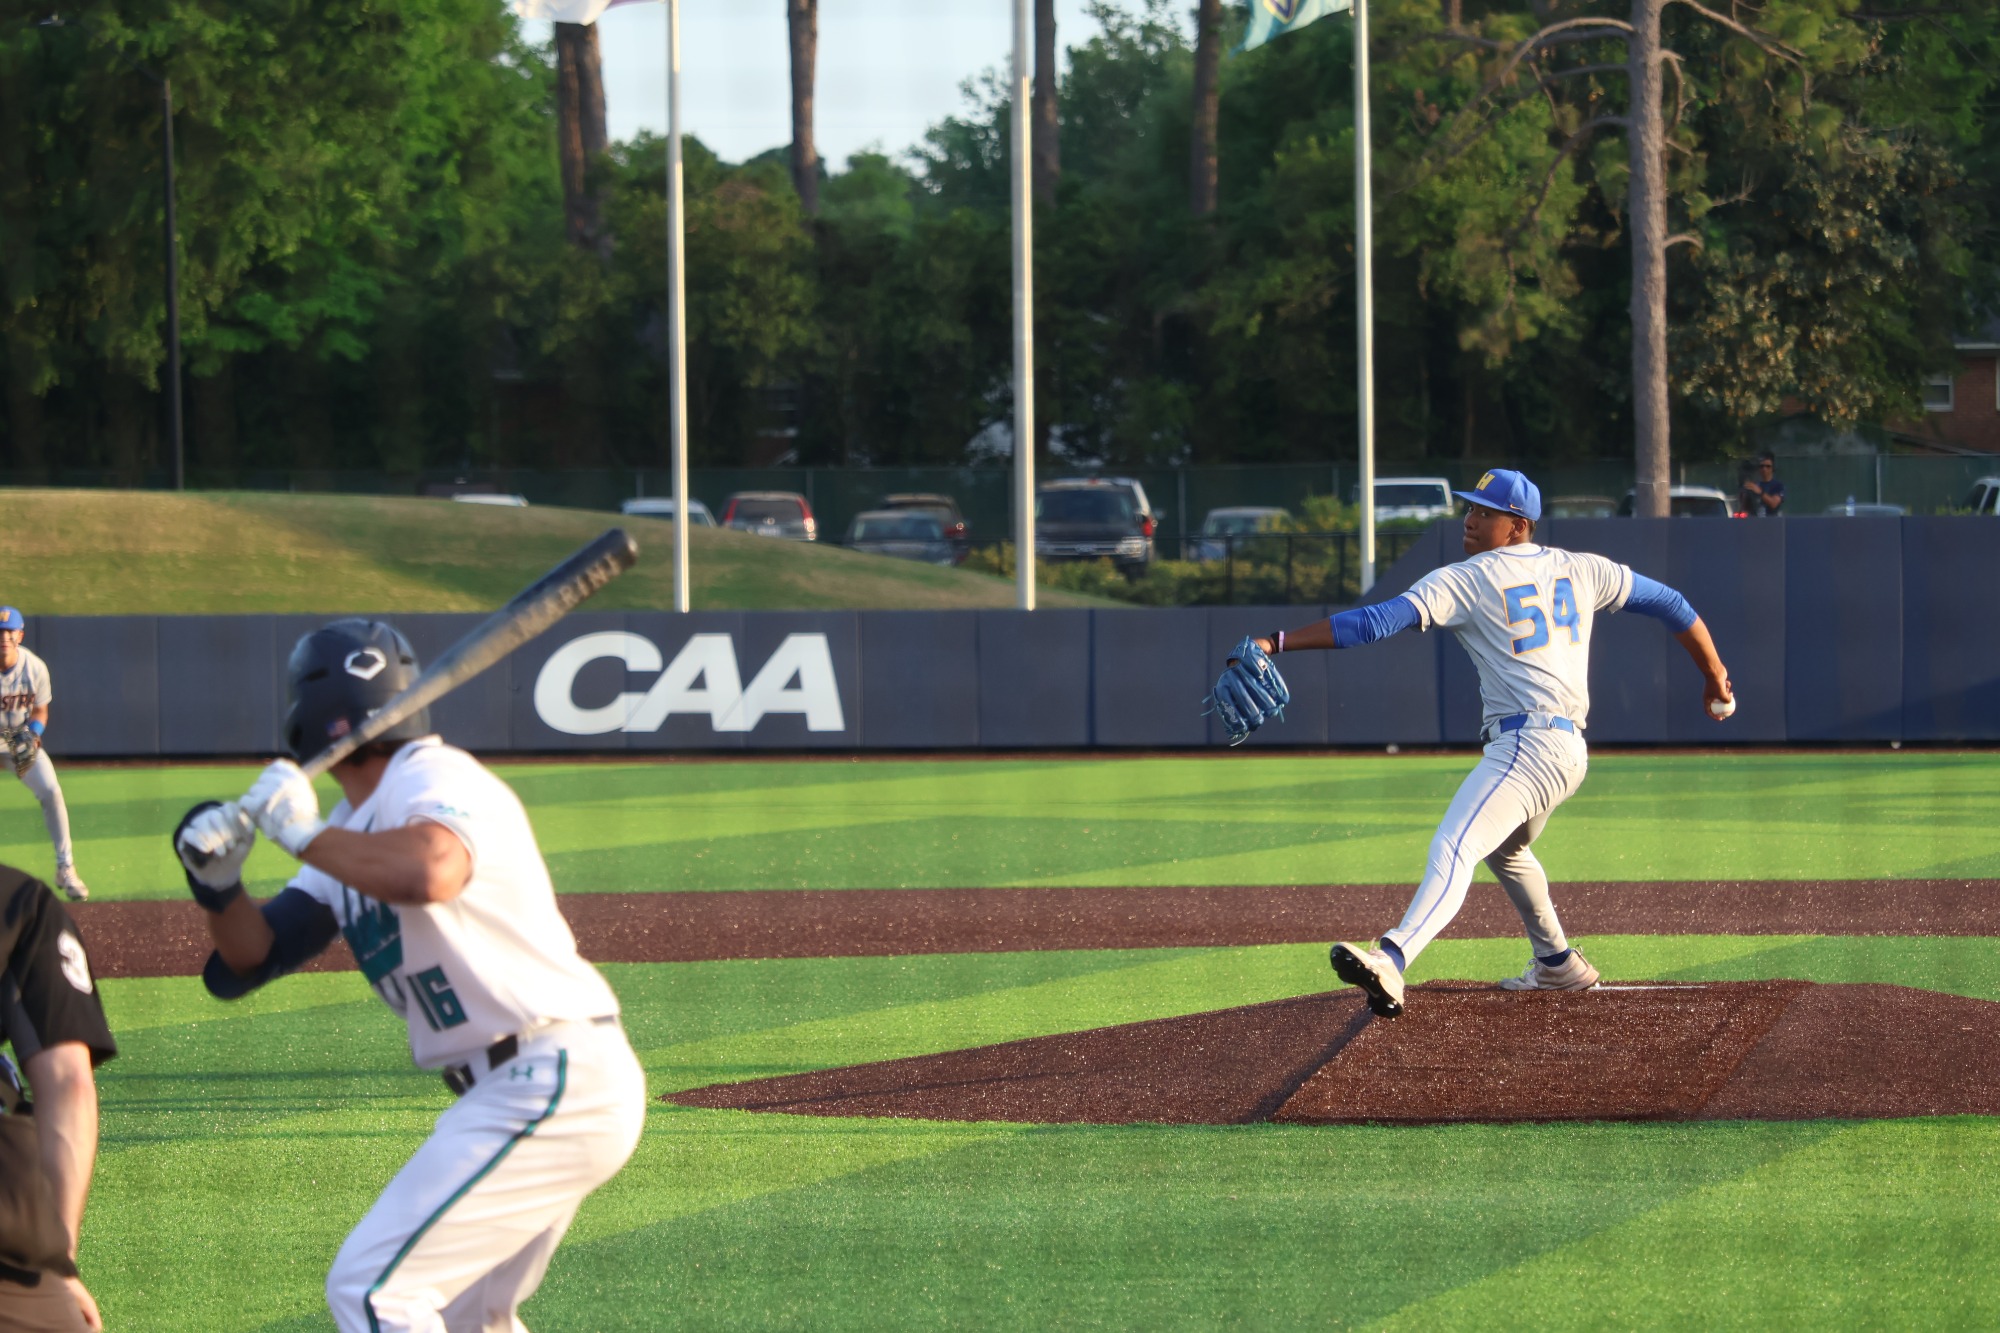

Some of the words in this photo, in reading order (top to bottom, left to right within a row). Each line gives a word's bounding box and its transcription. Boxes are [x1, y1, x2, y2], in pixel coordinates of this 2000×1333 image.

[1503, 576, 1582, 656] 54
[534, 631, 845, 735] CAA
[57, 929, 93, 995] 3
[405, 964, 469, 1032] 16
